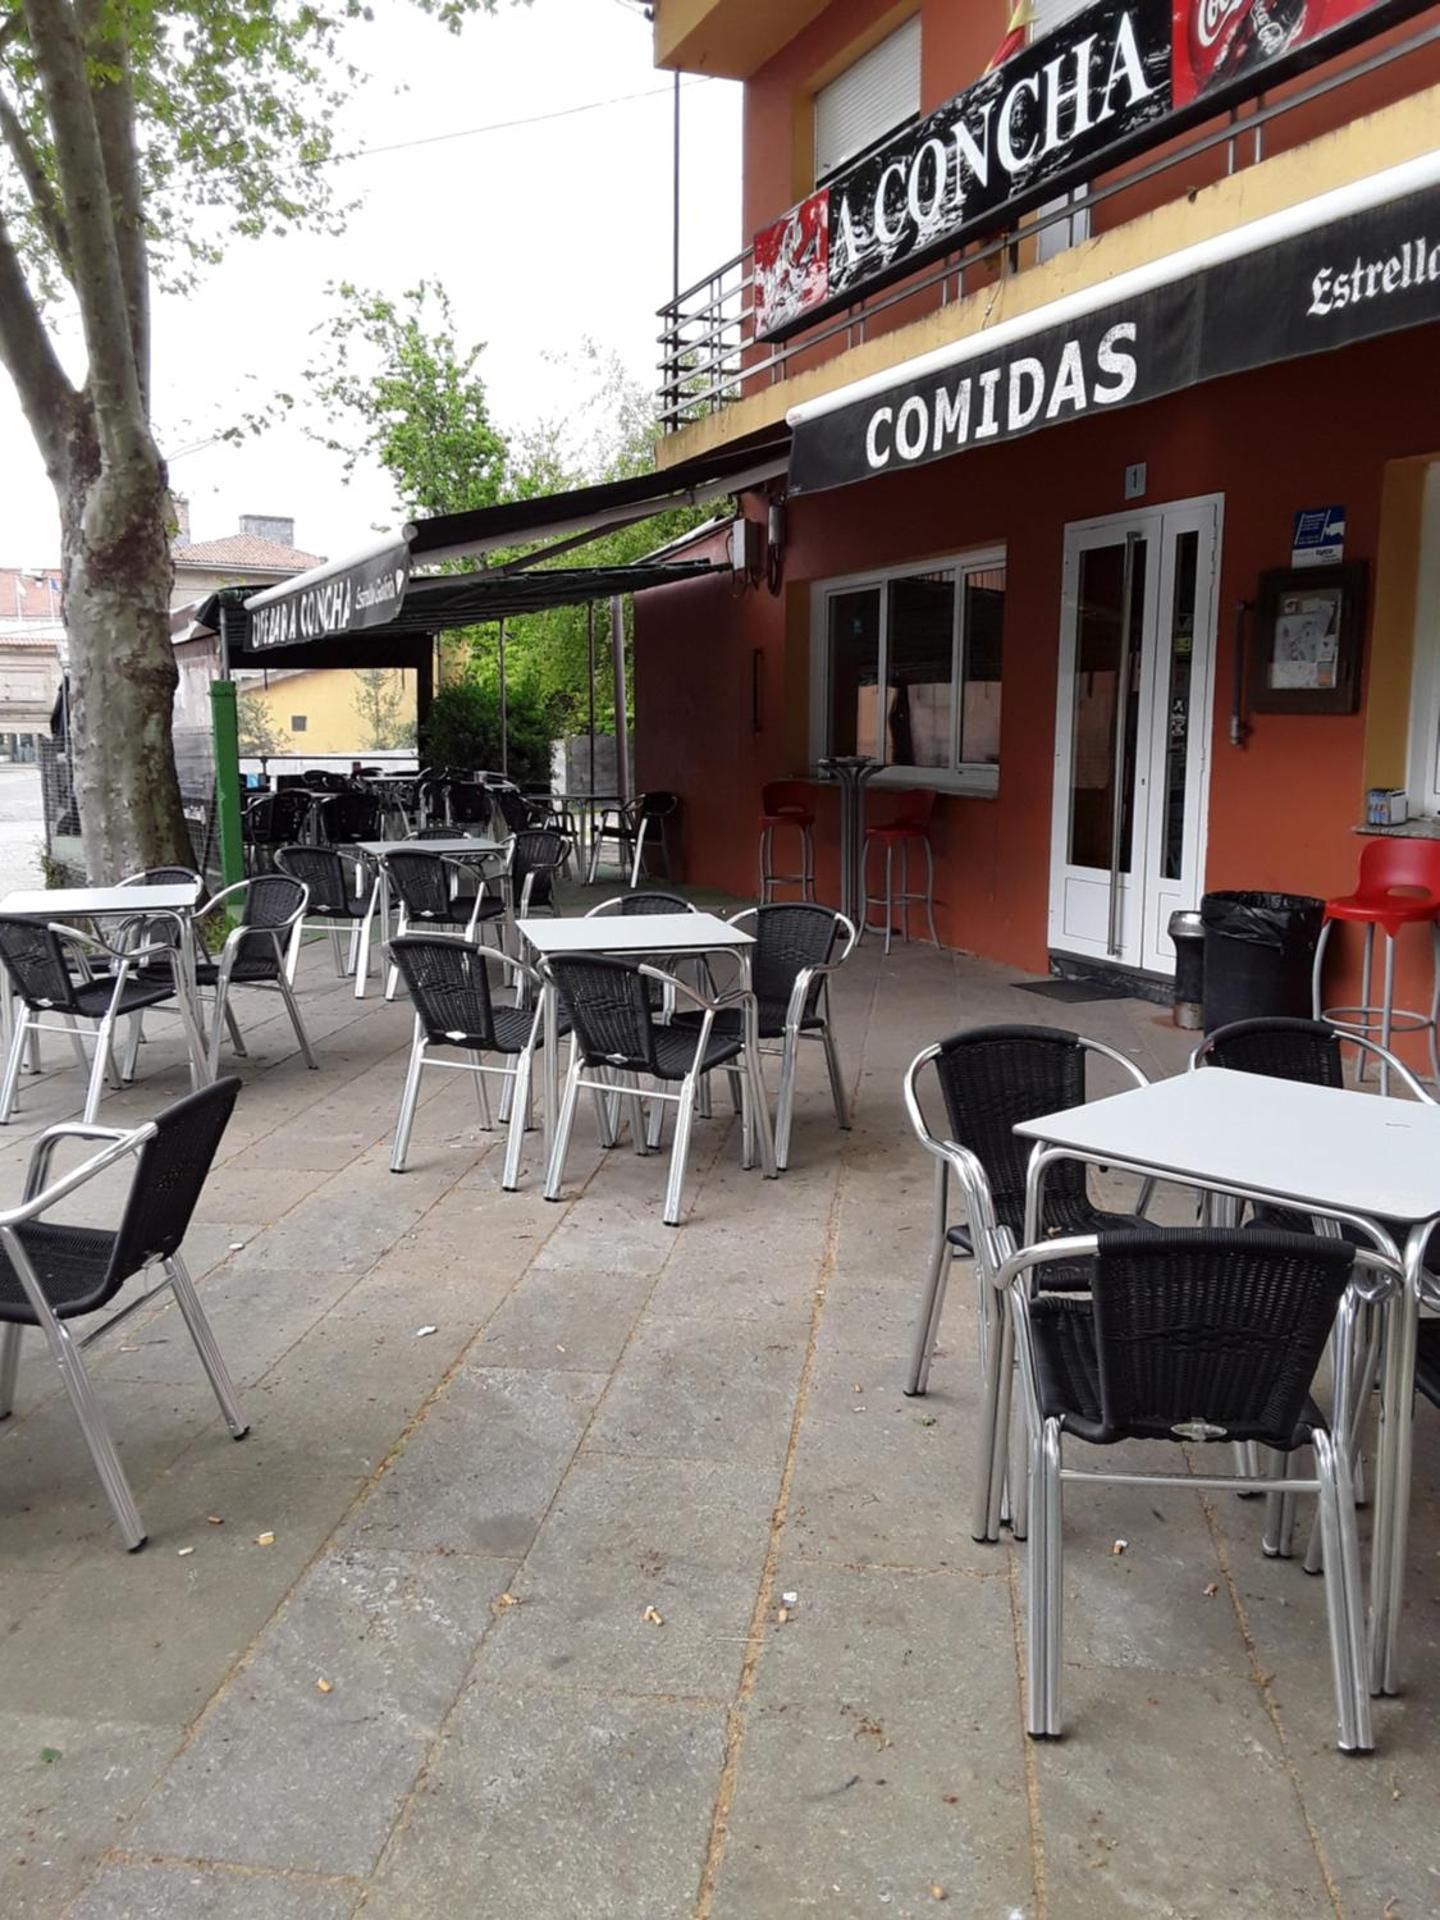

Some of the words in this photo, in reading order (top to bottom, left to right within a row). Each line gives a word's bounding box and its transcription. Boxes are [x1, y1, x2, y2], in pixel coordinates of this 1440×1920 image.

[873, 10, 1154, 244] CONCHA
[865, 321, 1138, 469] COMIDAS
[301, 577, 351, 637] CONCHA
